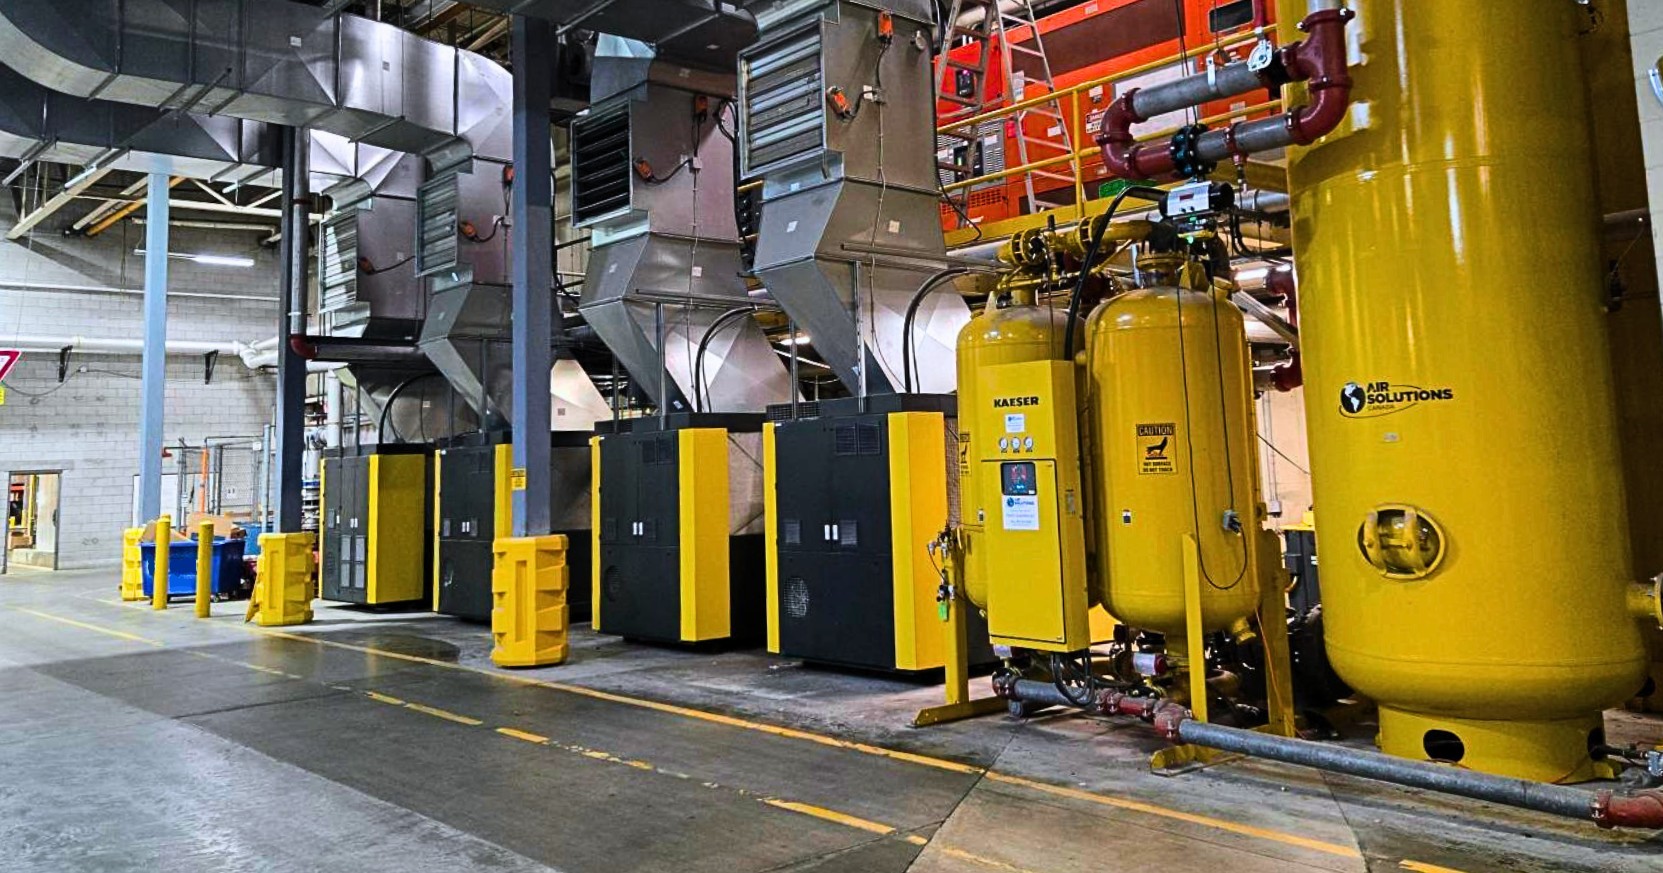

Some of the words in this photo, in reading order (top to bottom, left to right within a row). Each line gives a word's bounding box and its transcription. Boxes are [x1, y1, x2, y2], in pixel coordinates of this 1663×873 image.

[1367, 382, 1389, 393] AIR
[993, 396, 1039, 408] KAESER
[1367, 389, 1453, 404] SOLUTIONS
[1139, 426, 1174, 436] CAUTION
